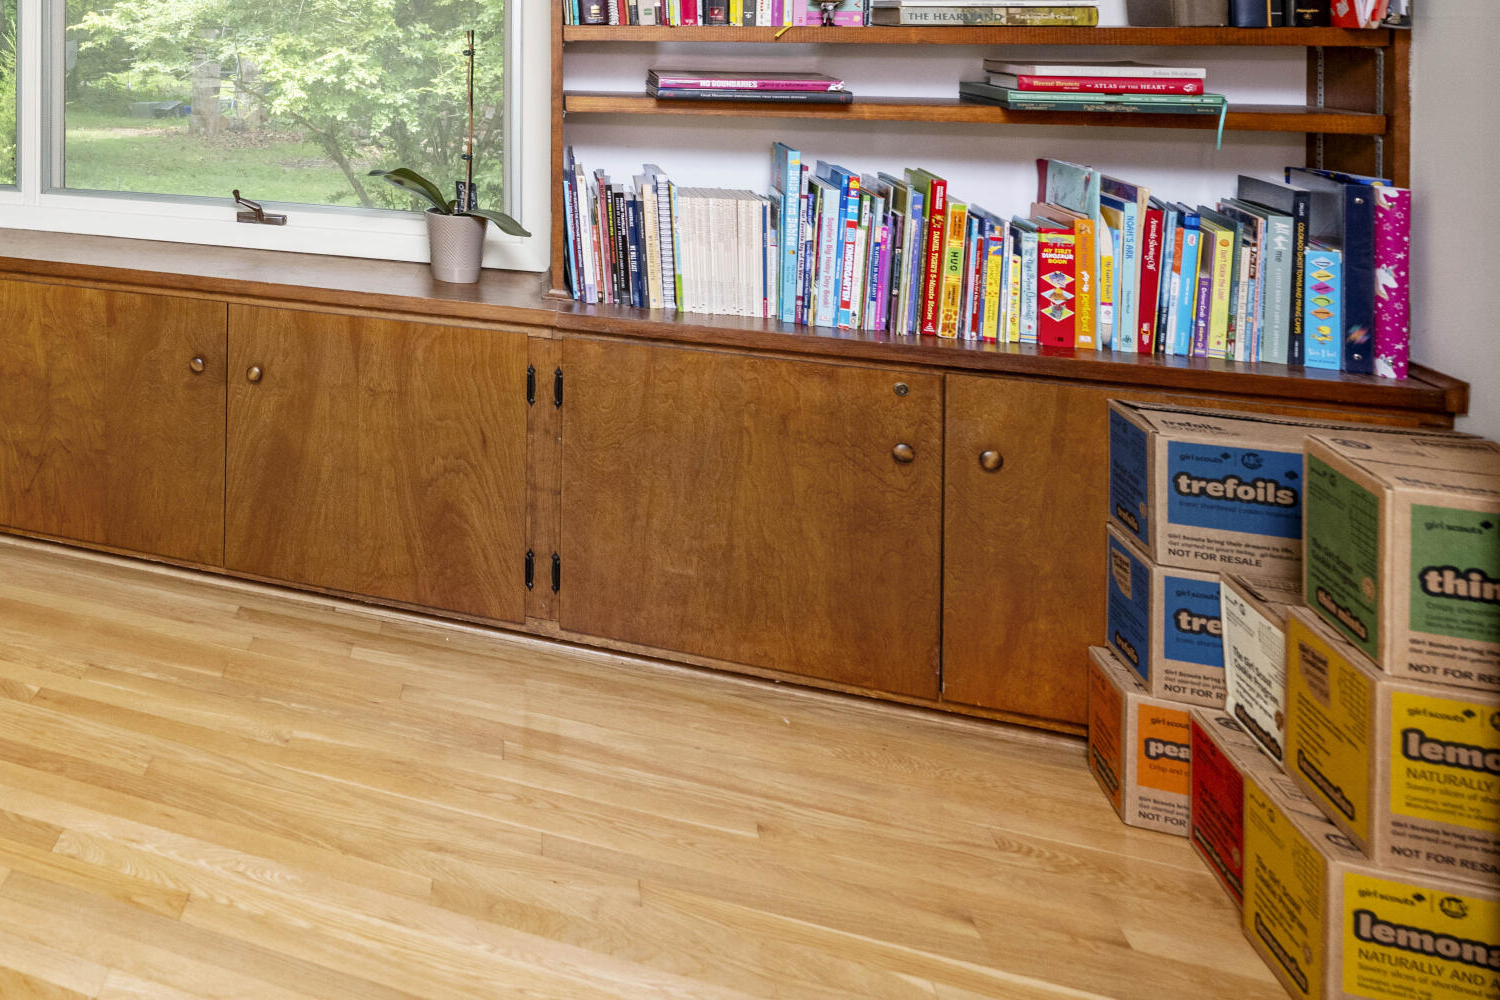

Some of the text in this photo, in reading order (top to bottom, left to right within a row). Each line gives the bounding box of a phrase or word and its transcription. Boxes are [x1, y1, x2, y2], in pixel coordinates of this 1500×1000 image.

[908, 12, 1004, 21] THE HEARTLAND
[712, 80, 758, 88] BOUNDARIES
[1093, 82, 1117, 90] ATLAS
[1125, 215, 1134, 259] NOAH'S ARK
[842, 227, 855, 301] BIG KINDERGARTEN
[950, 251, 959, 272] HUG
[926, 231, 941, 320] DANIEL TIGER'S 5-Minute Stories
[1180, 454, 1223, 464] girl scouts
[1176, 473, 1295, 506] trefoils
[1424, 521, 1484, 535] girl scouts
[1168, 548, 1262, 567] NOT FOR RESALE
[1408, 662, 1473, 681] NOT FOR
[1164, 684, 1213, 699] NOT FOR
[1407, 708, 1466, 723] girl scouts
[1406, 767, 1494, 792] NATURALLY
[1138, 811, 1187, 827] NOT FOR
[1392, 846, 1421, 859] NOT
[1426, 849, 1456, 864] FOR
[1358, 888, 1416, 907] girl scouts
[1358, 948, 1485, 987] NATURALLY AND
